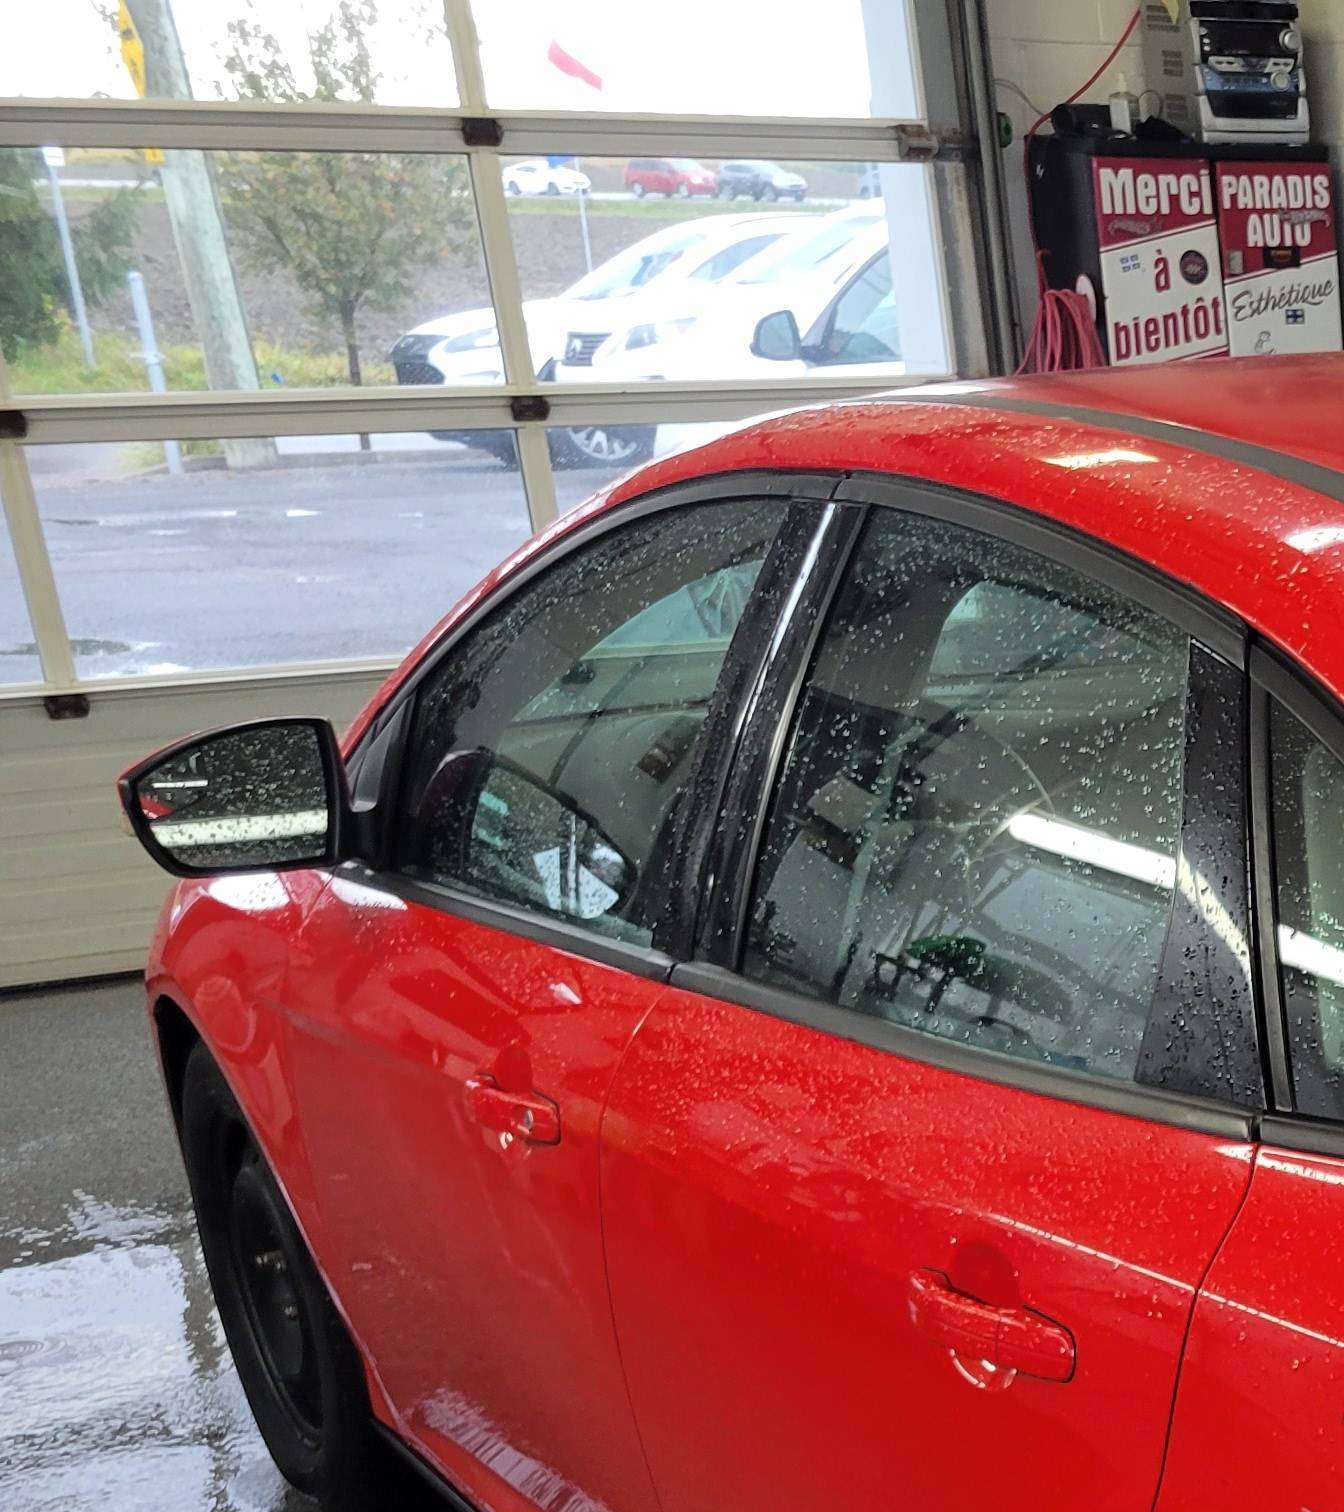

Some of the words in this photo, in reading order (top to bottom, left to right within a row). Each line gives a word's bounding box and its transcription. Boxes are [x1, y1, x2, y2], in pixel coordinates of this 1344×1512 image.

[1099, 167, 1213, 215] Merci
[1221, 174, 1331, 210] PARADIS
[1154, 249, 1171, 293] à
[1113, 296, 1223, 362] bientôt
